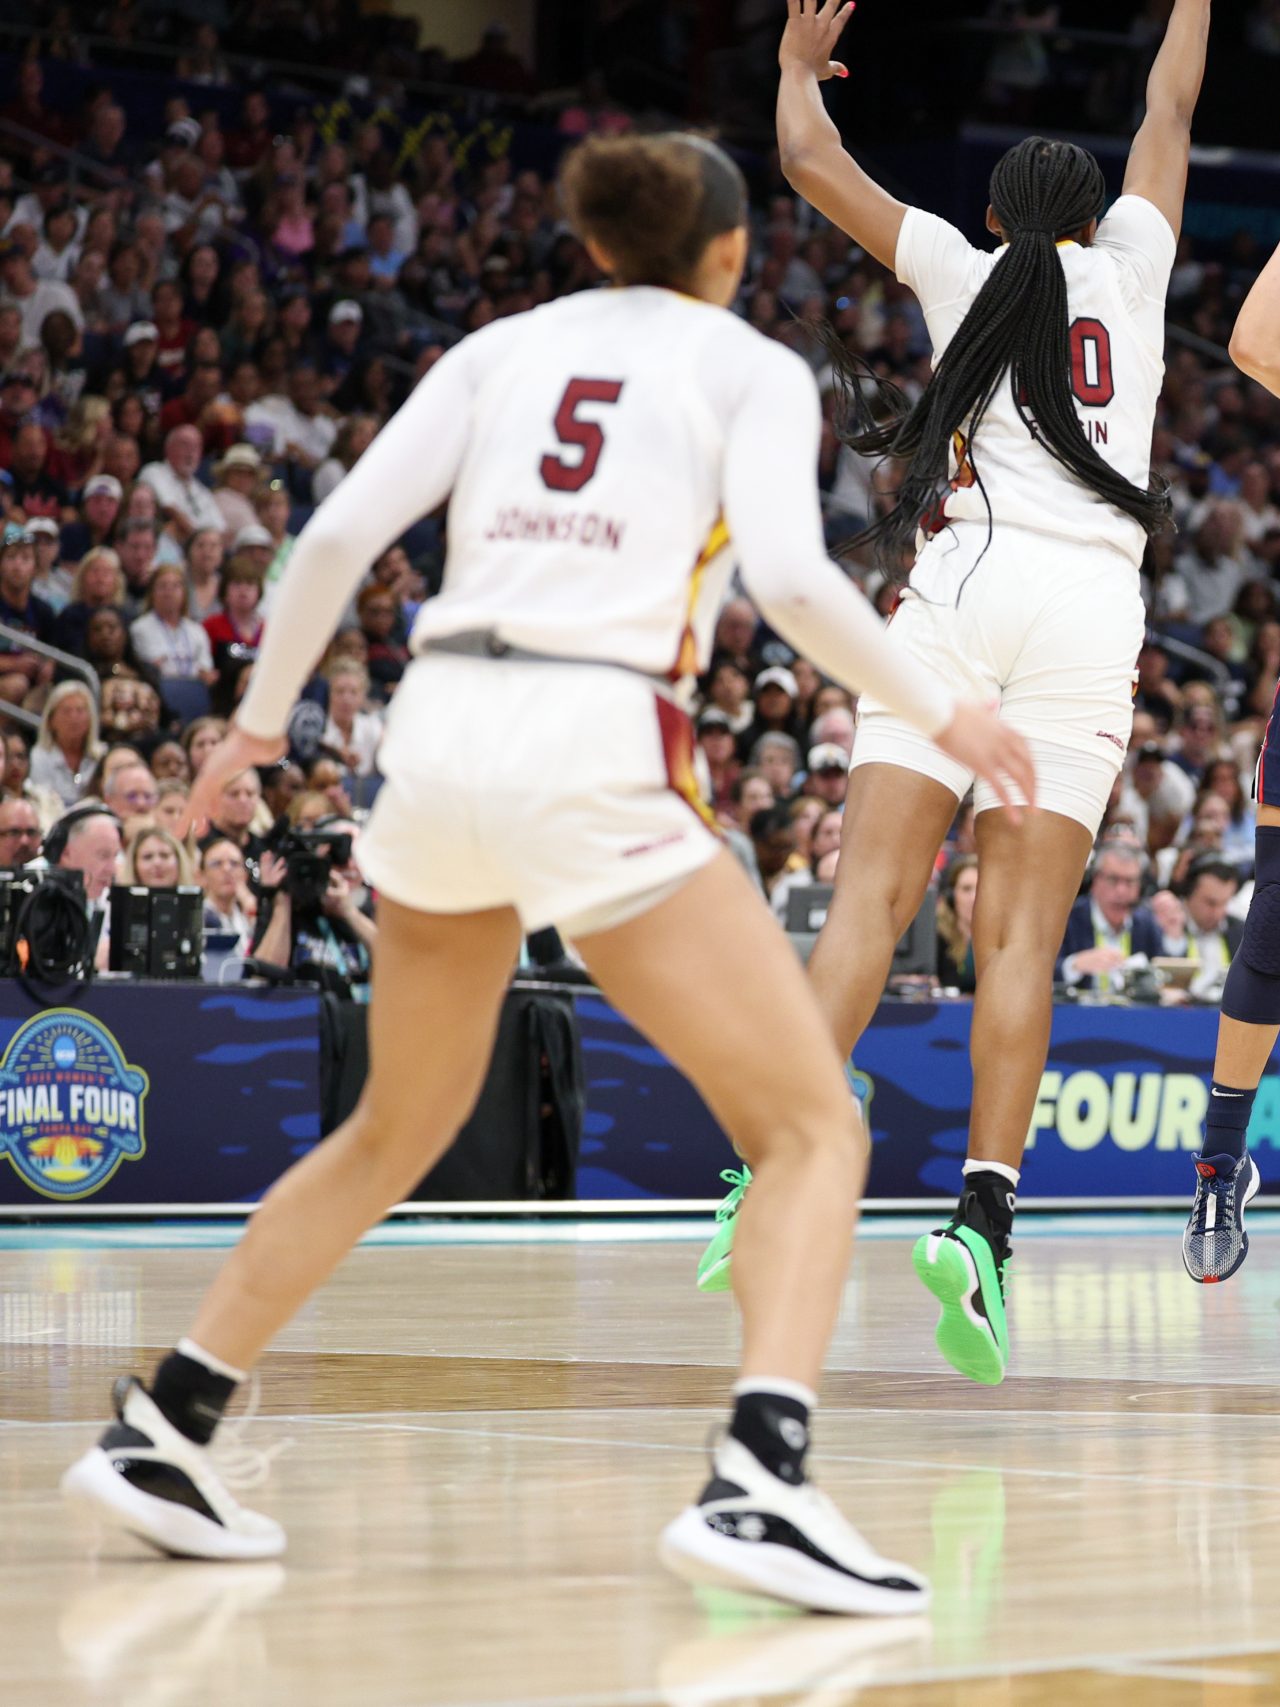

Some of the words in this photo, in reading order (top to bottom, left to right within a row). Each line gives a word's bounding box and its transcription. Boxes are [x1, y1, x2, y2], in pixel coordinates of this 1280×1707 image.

[539, 378, 623, 493] 5
[484, 505, 626, 551] JOHNSON
[69, 1084, 138, 1132] FOUR
[1024, 1070, 1209, 1152] FOUR
